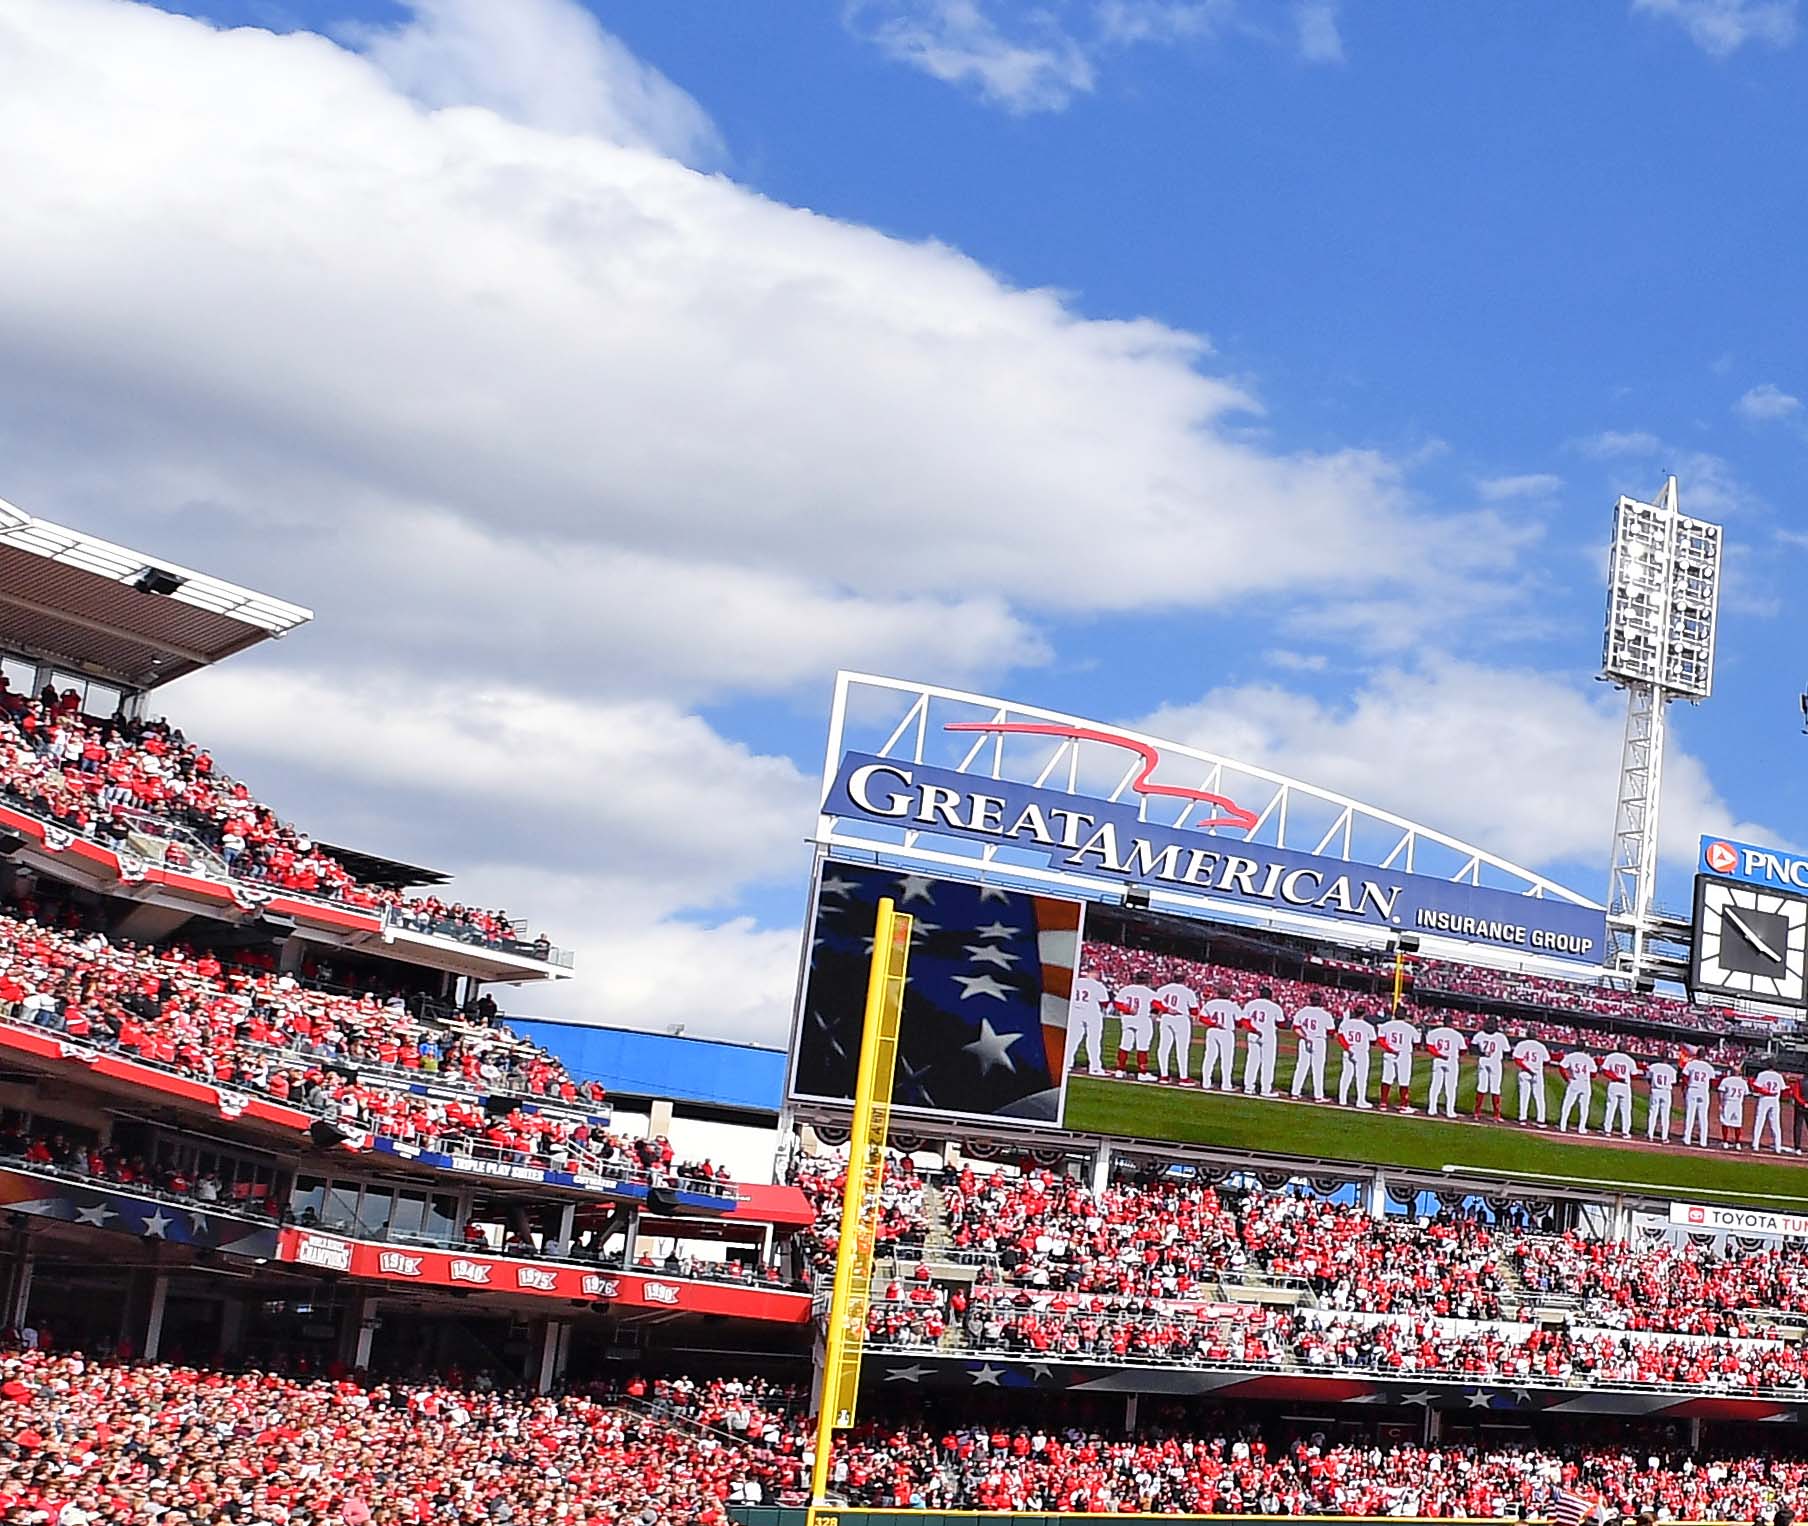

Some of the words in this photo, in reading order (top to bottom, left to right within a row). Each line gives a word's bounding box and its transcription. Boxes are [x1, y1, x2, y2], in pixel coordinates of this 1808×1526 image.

[1416, 907, 1527, 944] INSURANCE
[1532, 927, 1593, 955] GROUP
[1713, 1210, 1777, 1229] TOYOTA
[452, 1261, 483, 1281] 1940
[520, 1269, 549, 1289] 1975
